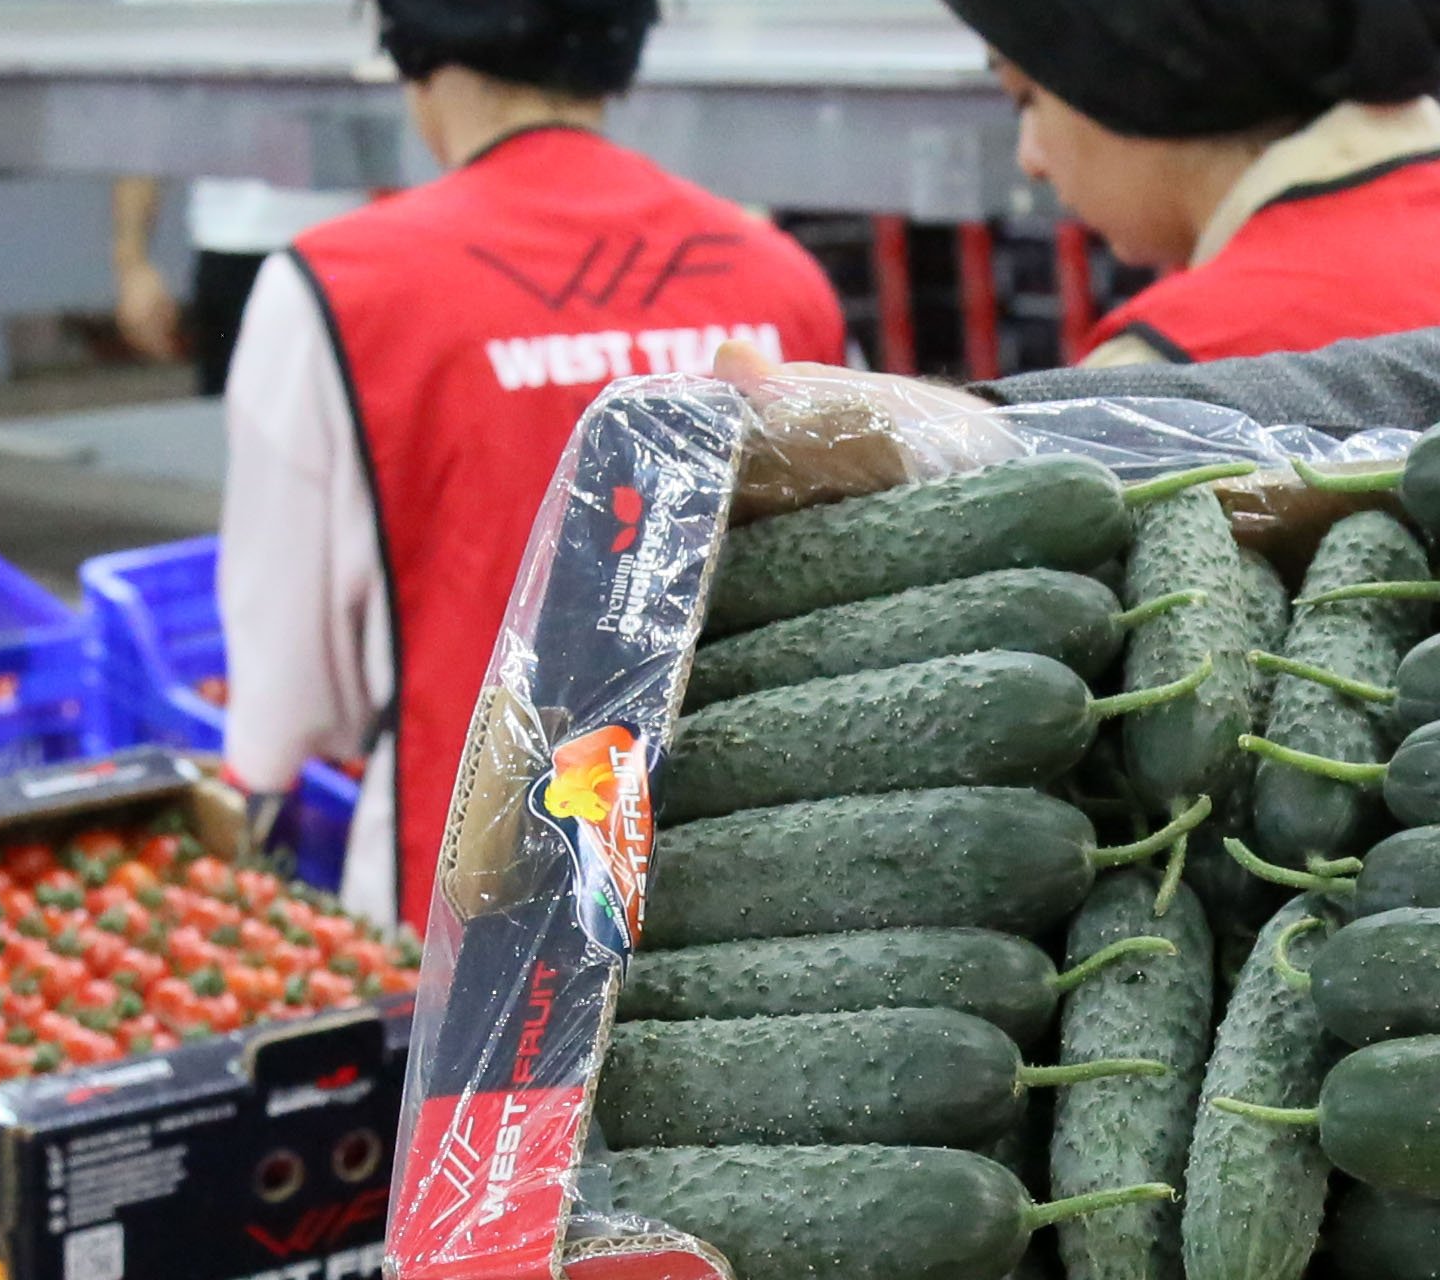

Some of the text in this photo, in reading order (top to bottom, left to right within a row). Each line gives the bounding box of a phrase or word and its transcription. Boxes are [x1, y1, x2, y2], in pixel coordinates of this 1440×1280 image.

[485, 330, 633, 391] WEST
[596, 552, 634, 633] Premium
[608, 746, 648, 843] FRUIT
[478, 959, 557, 1227] WEST FRUIT
